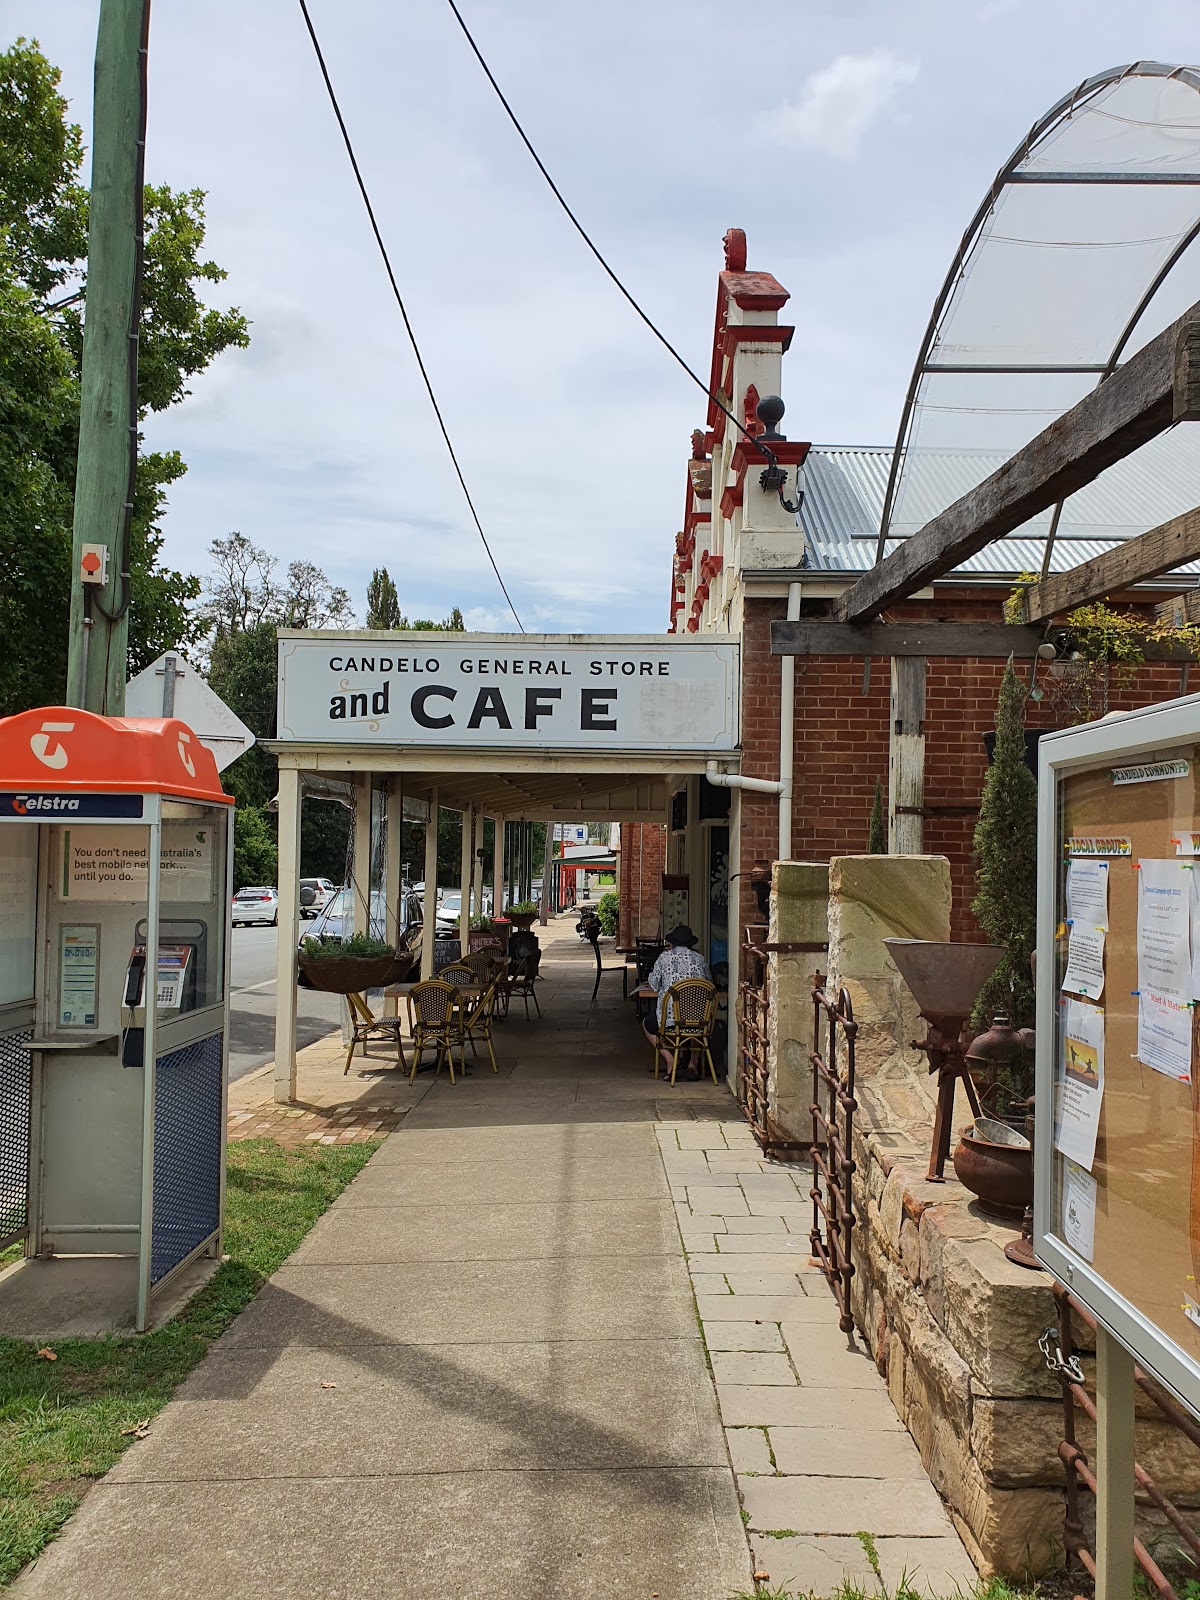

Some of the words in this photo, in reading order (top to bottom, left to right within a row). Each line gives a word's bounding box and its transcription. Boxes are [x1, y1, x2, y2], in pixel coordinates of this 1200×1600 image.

[329, 656, 441, 673] CANDELO
[459, 658, 573, 676] GENERAL
[588, 660, 671, 676] STORE
[329, 680, 390, 721] and
[410, 684, 618, 731] CAFE
[1115, 766, 1144, 781] CANDELO
[12, 795, 80, 815] Telstra
[74, 847, 92, 858] You
[95, 847, 120, 858] don't
[122, 847, 146, 858] need
[160, 848, 202, 858] stralia's
[1071, 838, 1096, 853] LOCAL
[74, 860, 96, 869] best
[98, 860, 132, 869] mobile
[134, 860, 187, 870] netork...
[74, 872, 96, 881] until
[98, 873, 116, 883] you
[119, 872, 134, 881] do.
